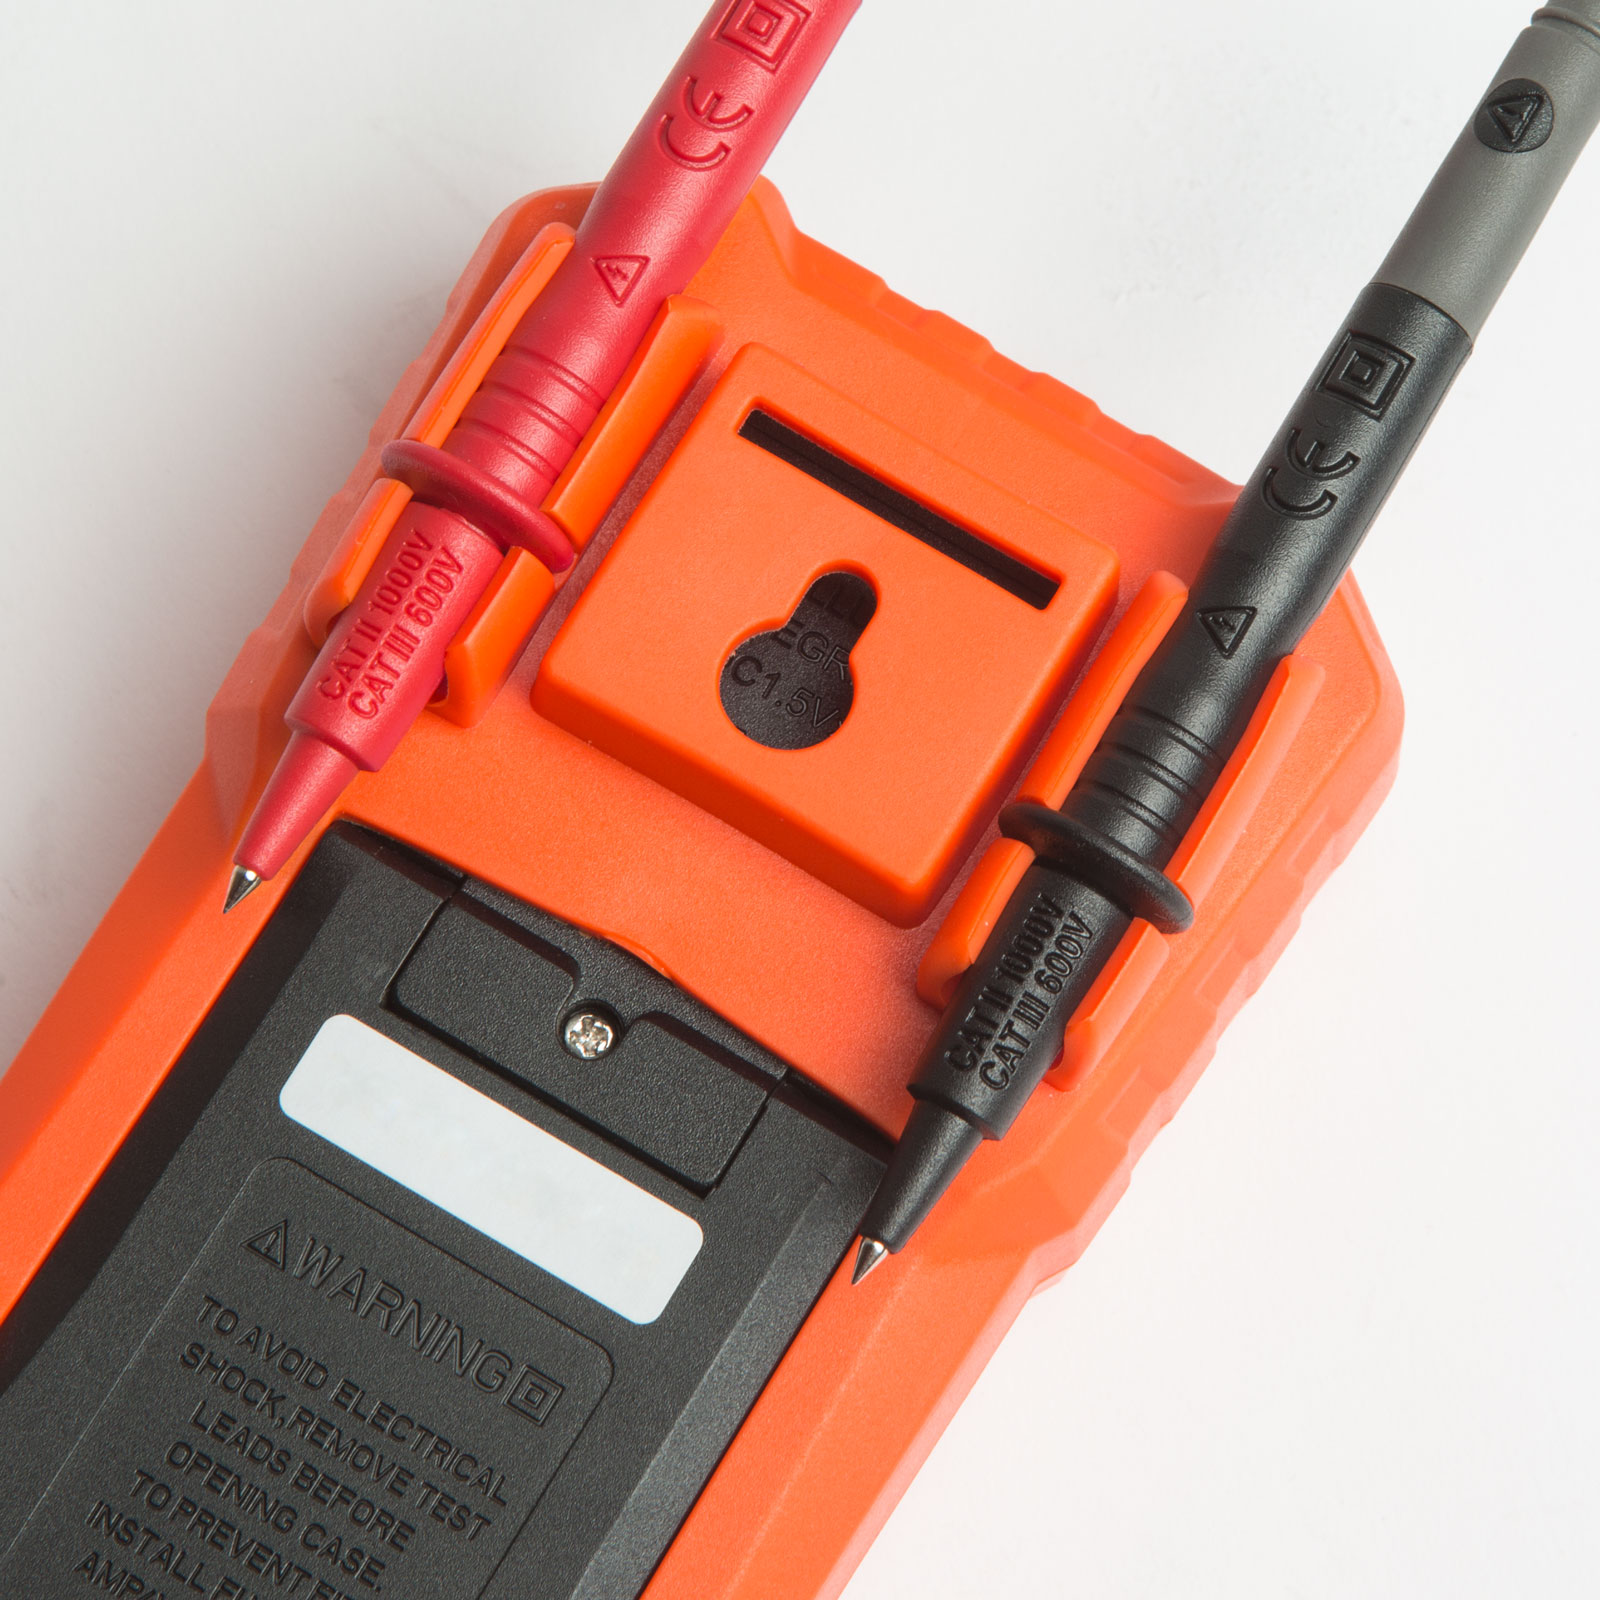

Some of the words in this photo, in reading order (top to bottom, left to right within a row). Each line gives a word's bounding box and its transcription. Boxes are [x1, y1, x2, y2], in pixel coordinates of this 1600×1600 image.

[316, 639, 368, 700] CAT
[353, 617, 382, 642] II
[368, 528, 433, 615] 1000V
[347, 653, 400, 719] CAT
[380, 624, 420, 662] III
[404, 546, 463, 627] 600V
[944, 1006, 1000, 1071] CAT
[994, 892, 1065, 984] 1000V
[979, 1019, 1031, 1091] CAT
[1013, 991, 1050, 1031] III
[1034, 911, 1093, 995] 600V
[293, 1237, 512, 1392] WARNING
[188, 1400, 291, 1476] LEADS
[289, 1461, 416, 1551] BEFORE
[196, 1294, 239, 1336] TO
[234, 1325, 329, 1391] AVOID
[328, 1378, 506, 1508] ELECTRICAL
[85, 1500, 205, 1593] INSTALL
[129, 1468, 171, 1511] TO
[168, 1496, 312, 1594] PREVENT
[164, 1441, 297, 1534] OPENING
[299, 1523, 385, 1592] CASE.
[415, 1480, 492, 1541] TEST
